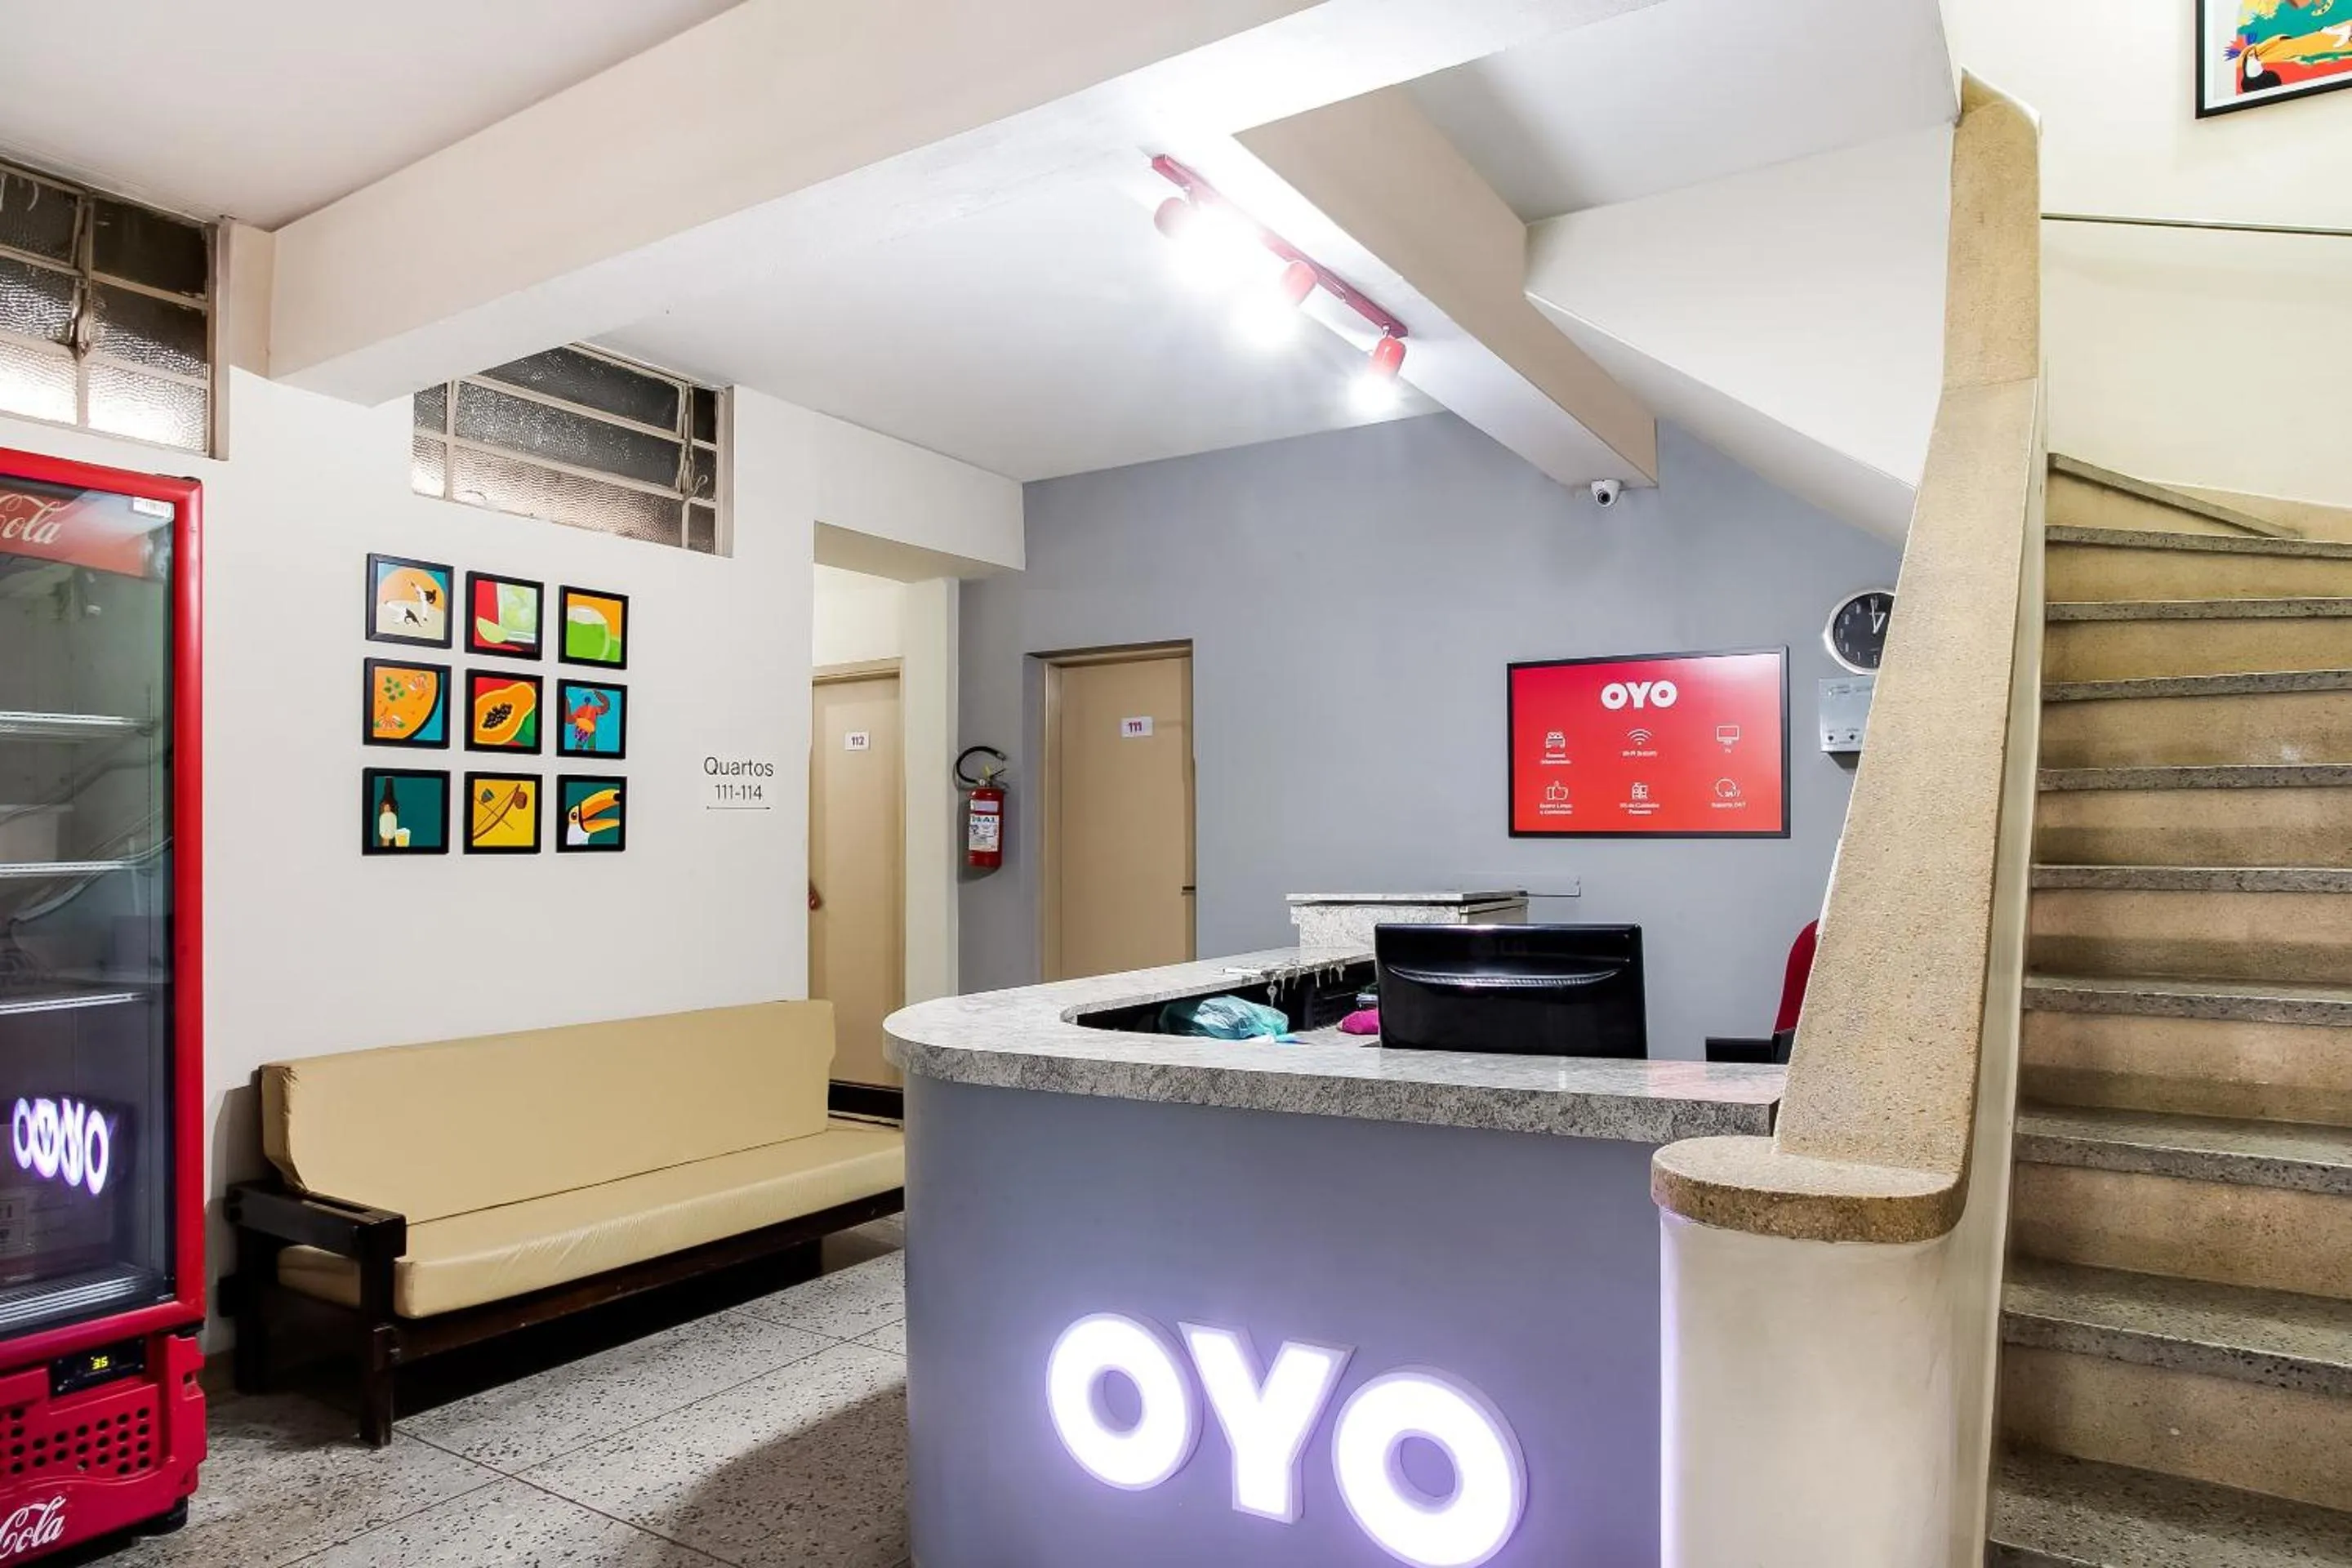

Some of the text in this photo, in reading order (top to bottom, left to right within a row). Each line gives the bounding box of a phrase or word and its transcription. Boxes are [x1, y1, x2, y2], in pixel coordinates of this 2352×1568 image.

[1601, 680, 1677, 710] OYO
[1129, 721, 1143, 733] 111
[851, 736, 865, 746] 112
[703, 756, 774, 777] Quartos
[715, 784, 763, 800] 111-114
[1045, 1311, 1529, 1568] OYO
[0, 1495, 67, 1560] Cola
